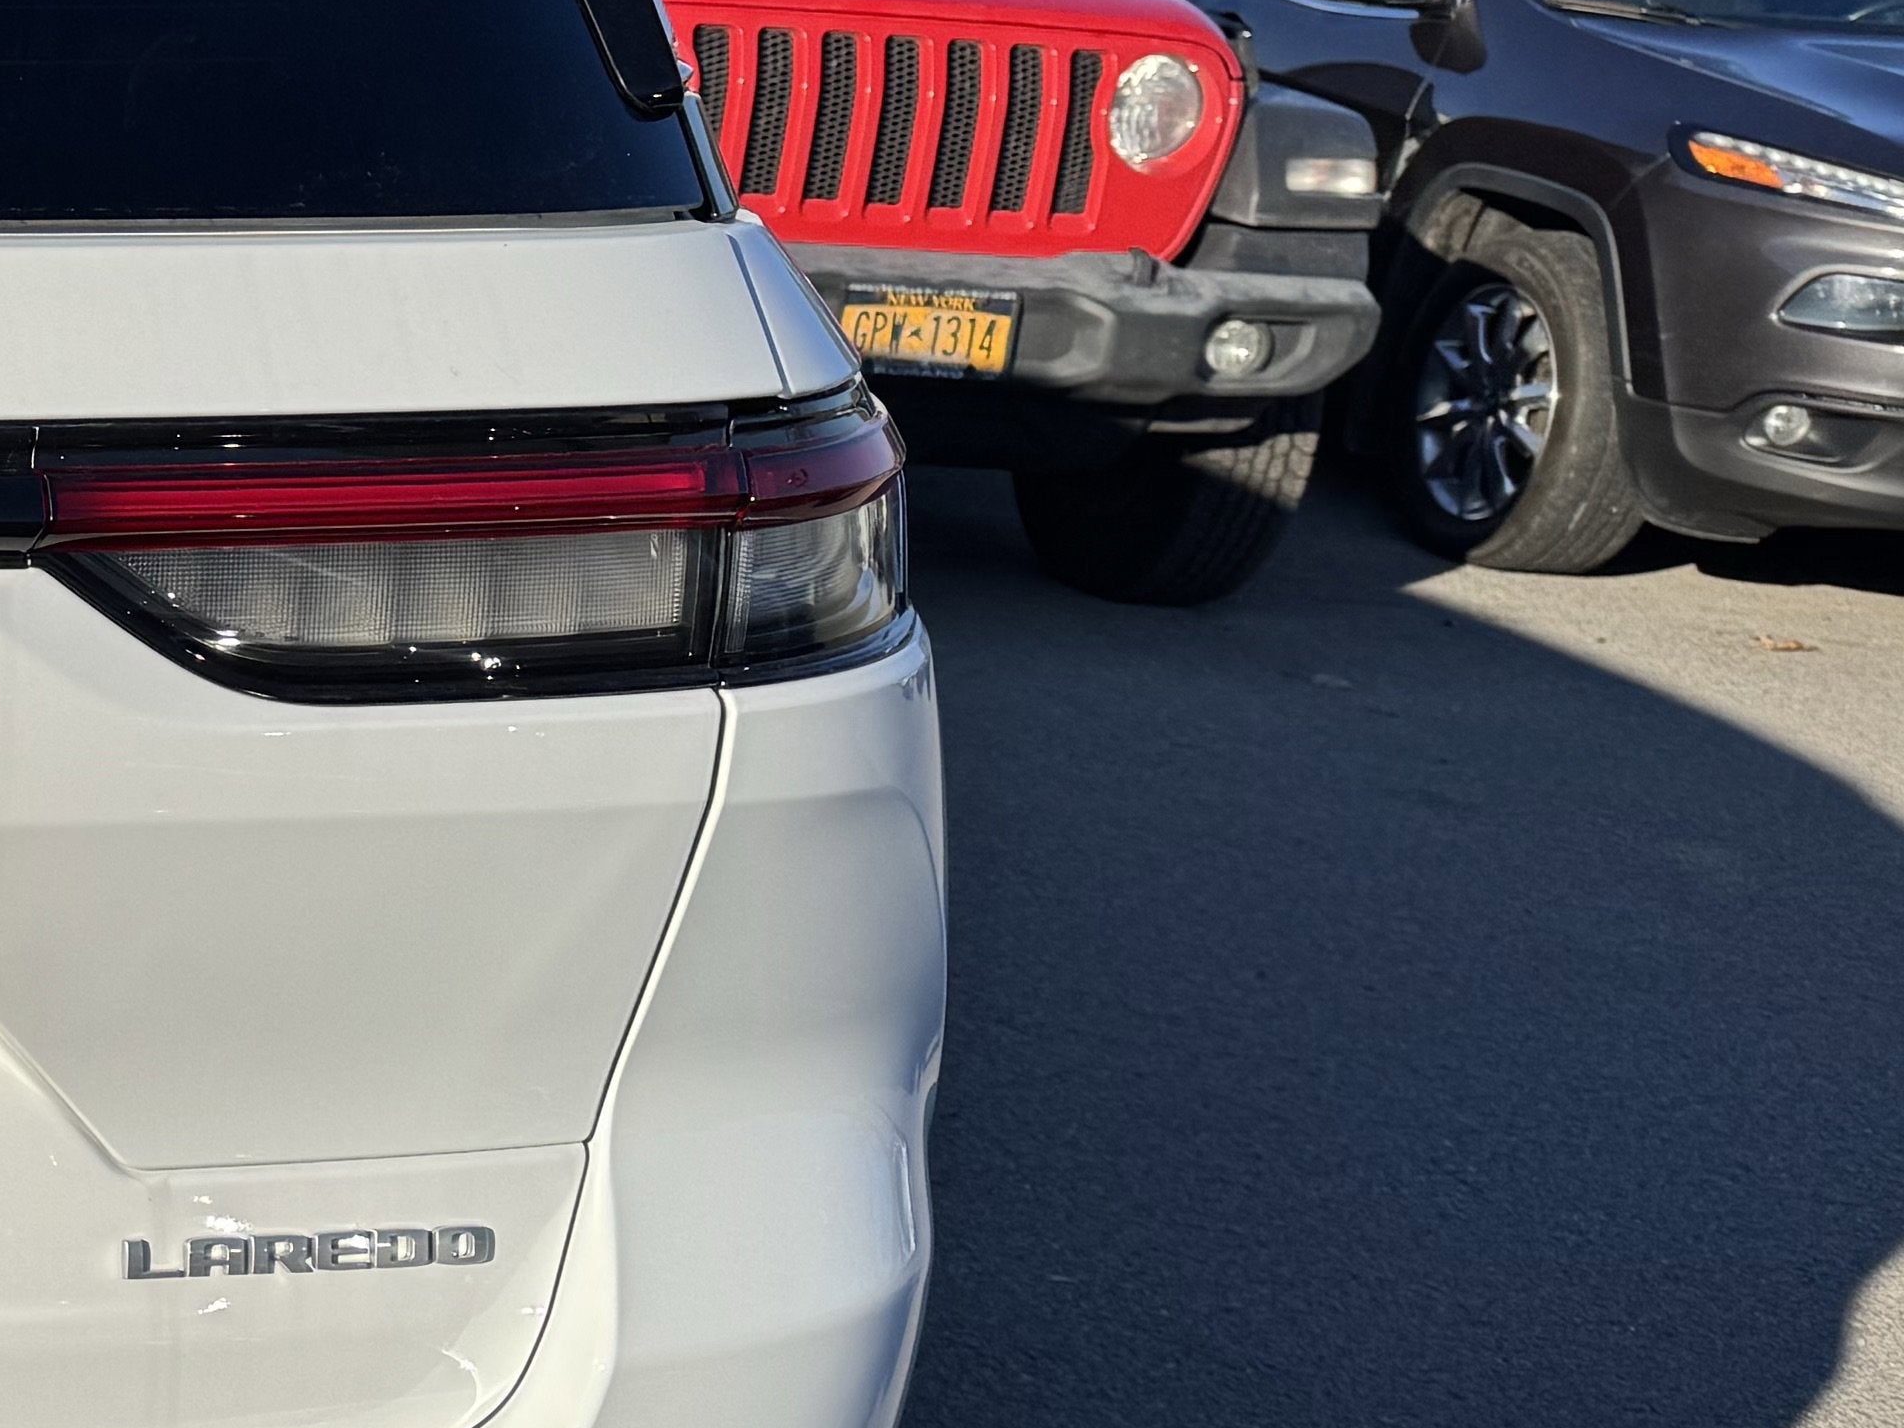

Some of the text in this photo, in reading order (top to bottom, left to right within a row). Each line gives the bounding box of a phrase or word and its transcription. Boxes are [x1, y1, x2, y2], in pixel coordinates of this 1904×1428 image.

[887, 289, 929, 307] NEW
[932, 293, 976, 312] YORK
[121, 1225, 497, 1280] LAREDO
